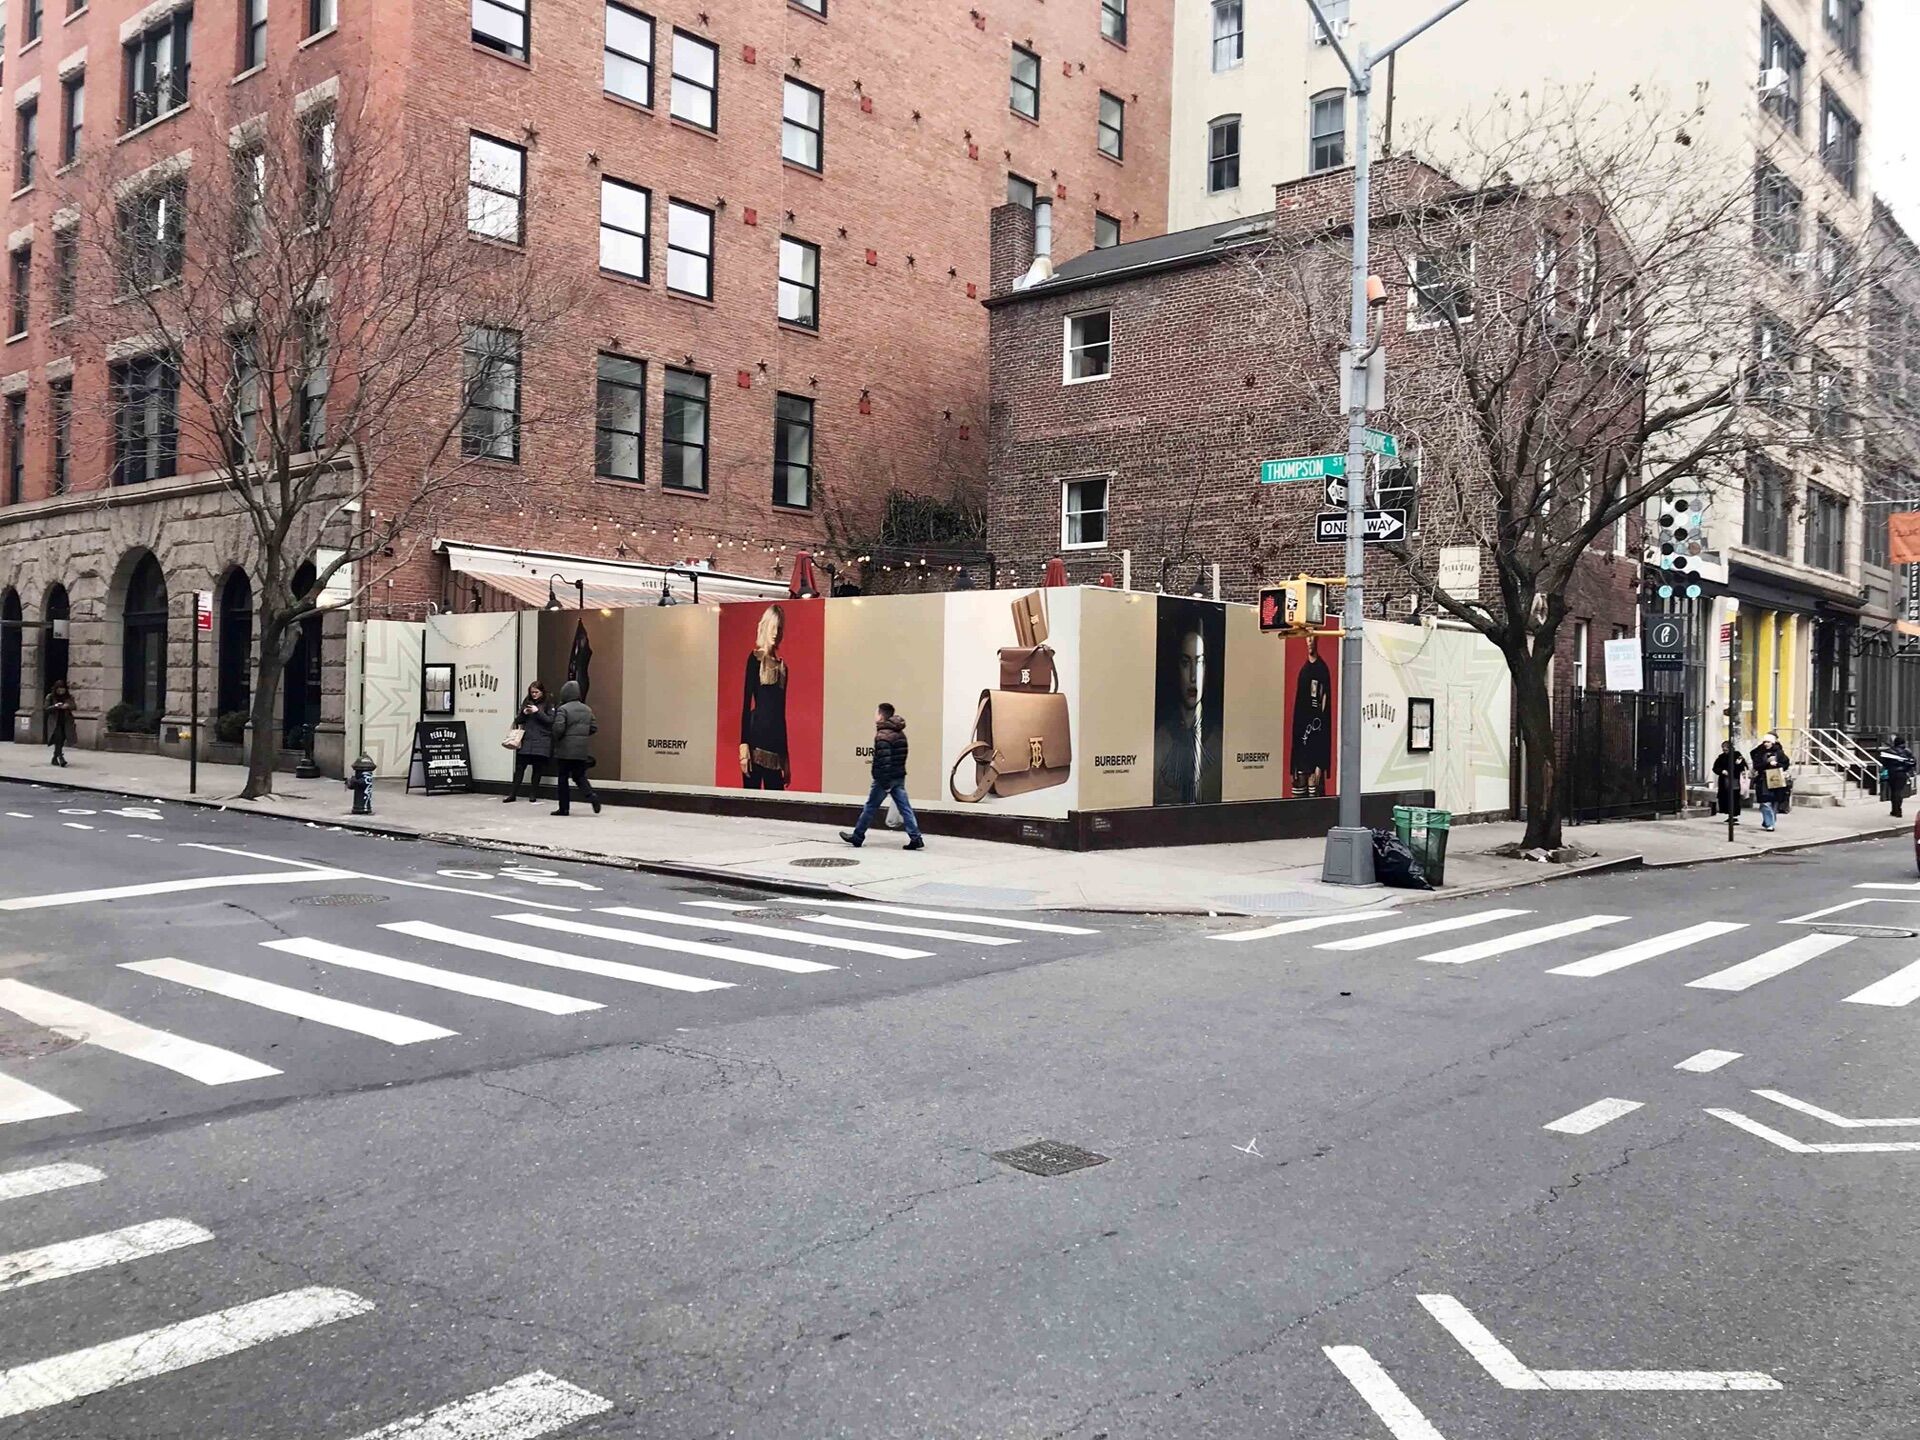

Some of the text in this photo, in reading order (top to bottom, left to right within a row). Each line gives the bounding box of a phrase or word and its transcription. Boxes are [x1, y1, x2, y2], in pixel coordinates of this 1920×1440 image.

[1267, 457, 1344, 480] THOMPSON ST
[1367, 519, 1395, 532] WAY
[458, 673, 477, 692] PERA
[1362, 703, 1378, 723] PERA
[647, 739, 688, 749] BURBERRY
[1094, 755, 1137, 767] BURBERRY
[1236, 752, 1270, 763] BURBERRY
